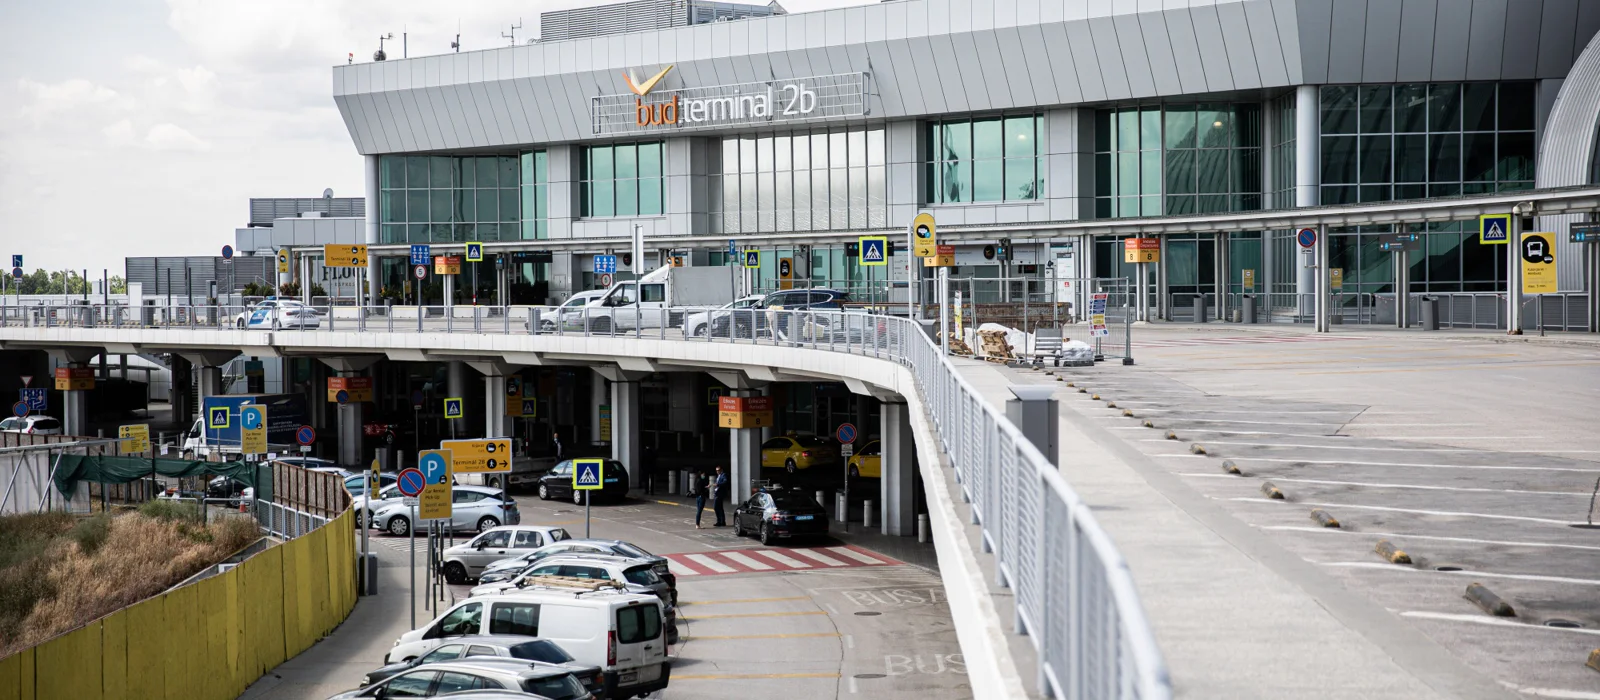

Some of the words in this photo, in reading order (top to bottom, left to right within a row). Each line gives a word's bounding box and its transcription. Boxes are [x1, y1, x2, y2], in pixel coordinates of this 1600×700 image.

[783, 84, 817, 116] 2b
[418, 268, 423, 276] 5
[247, 412, 256, 425] P
[427, 460, 438, 478] P
[841, 588, 926, 606] BUS
